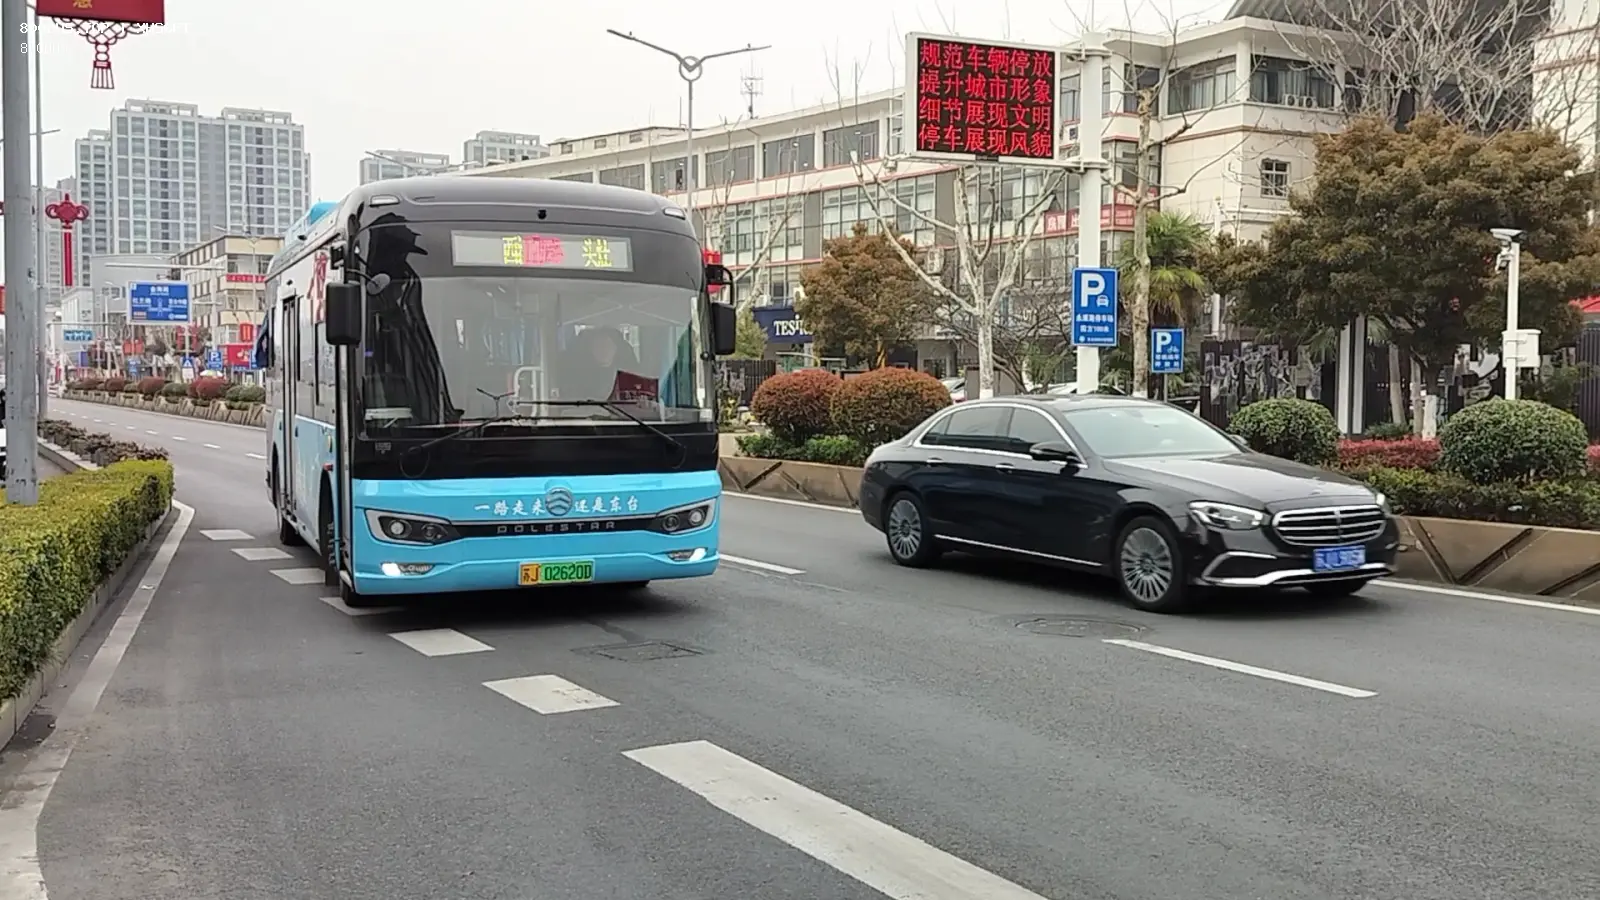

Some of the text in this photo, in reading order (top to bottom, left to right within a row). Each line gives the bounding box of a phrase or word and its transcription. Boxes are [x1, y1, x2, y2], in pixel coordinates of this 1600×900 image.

[919, 40, 1053, 78] 规范车辆停放
[919, 68, 1053, 105] 提升城市形象
[919, 96, 1053, 131] 细节展现文明
[918, 123, 1053, 157] 停车展现风貌
[1080, 272, 1106, 308] P
[1156, 331, 1172, 353] P
[474, 495, 639, 516] 一路走来 还是东台
